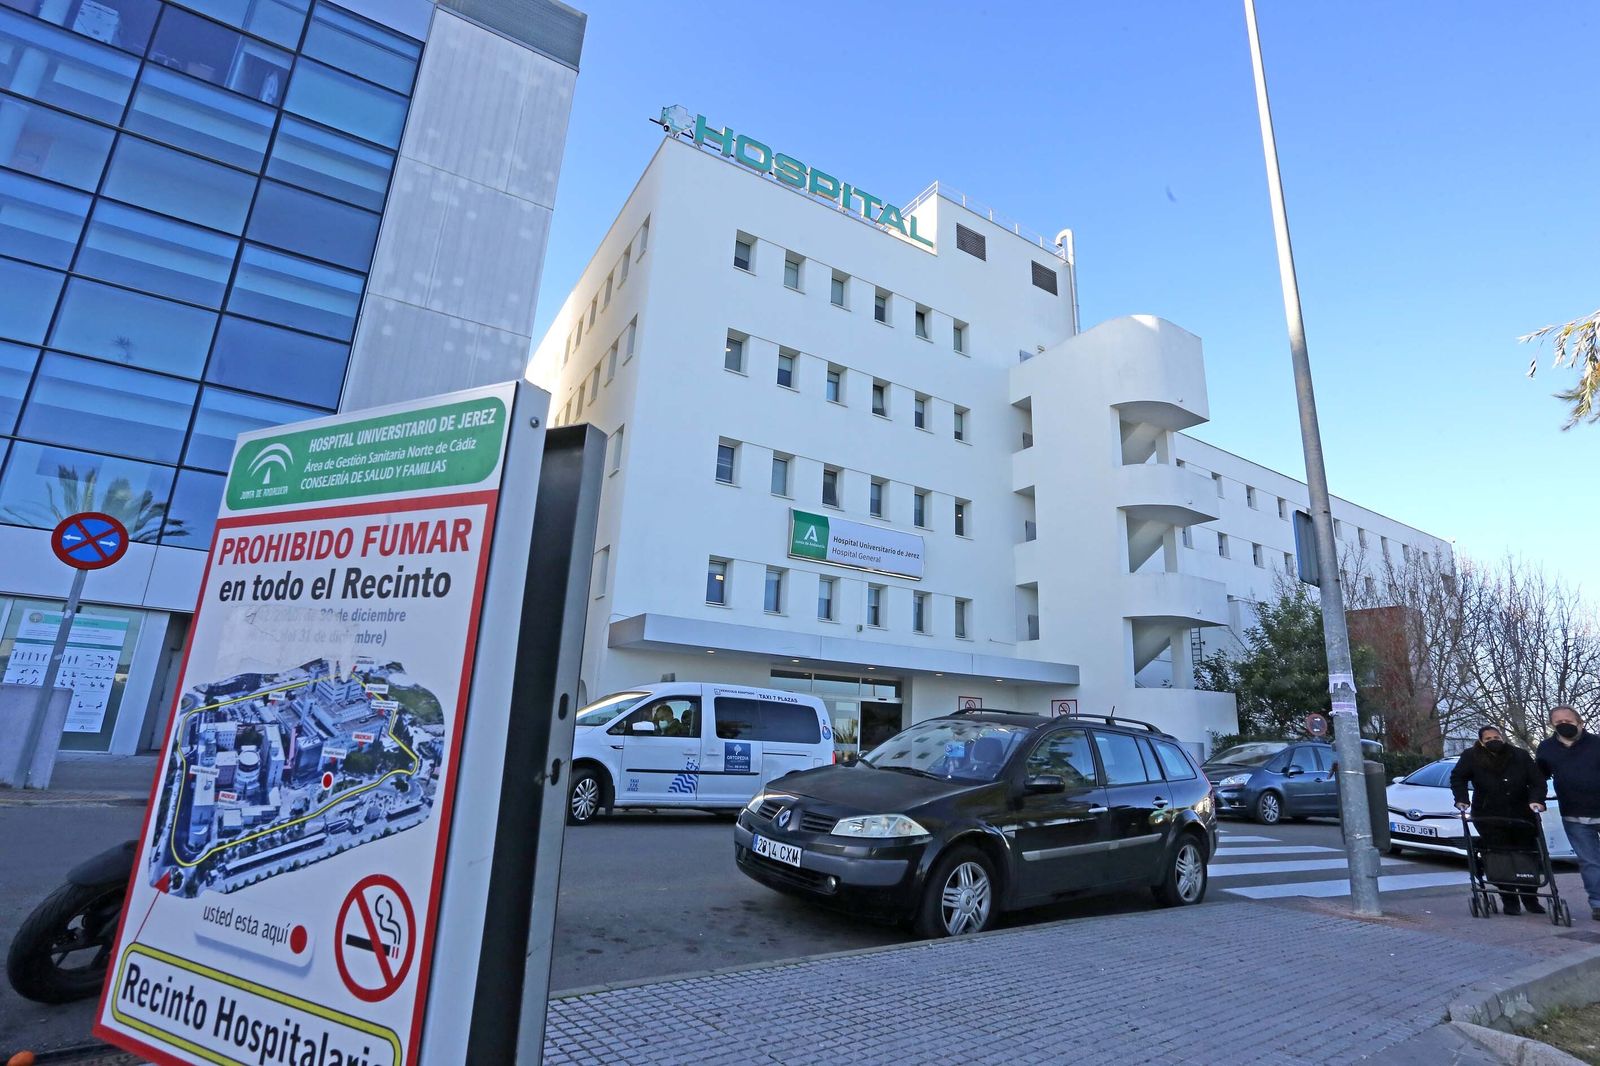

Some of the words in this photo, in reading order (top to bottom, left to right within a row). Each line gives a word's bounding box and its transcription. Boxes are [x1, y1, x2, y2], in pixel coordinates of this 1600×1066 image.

[694, 114, 933, 248] HOSPITAL
[309, 432, 354, 453] HOSPITAL
[357, 418, 437, 445] UNIVERSITARIO
[439, 414, 456, 432] DE
[457, 407, 497, 429] JEREZ
[304, 458, 325, 473] Área
[324, 458, 335, 470] de
[336, 453, 367, 468] Gestión
[368, 447, 406, 463] Sanitaria
[407, 445, 434, 458] Norte
[435, 441, 448, 454] de
[449, 437, 477, 452] Cádiz
[300, 470, 349, 489] CONSEJERÍA
[350, 470, 363, 483] DE
[364, 466, 394, 482] SALUD
[395, 465, 403, 478] Y
[402, 459, 448, 477] FAMILIAS
[218, 527, 353, 565] PROHIBIDO
[360, 517, 472, 557] FUMAR
[832, 547, 858, 558] Hospital
[858, 552, 881, 563] General
[833, 535, 859, 547] Hospital
[859, 542, 897, 555] Universitario
[904, 550, 920, 559] Jerez
[219, 580, 245, 602] en
[252, 570, 304, 601] todo
[310, 568, 336, 600] el
[341, 565, 451, 600] Recinto
[351, 608, 406, 622] diciembre
[758, 693, 772, 701] TAXI
[1397, 824, 1416, 833] 1620
[780, 845, 799, 864] CXM
[202, 904, 232, 928] usted
[235, 914, 259, 937] esta
[262, 923, 291, 945] aquí
[121, 962, 207, 1031] Recinto
[213, 994, 382, 1066] Hospitala
